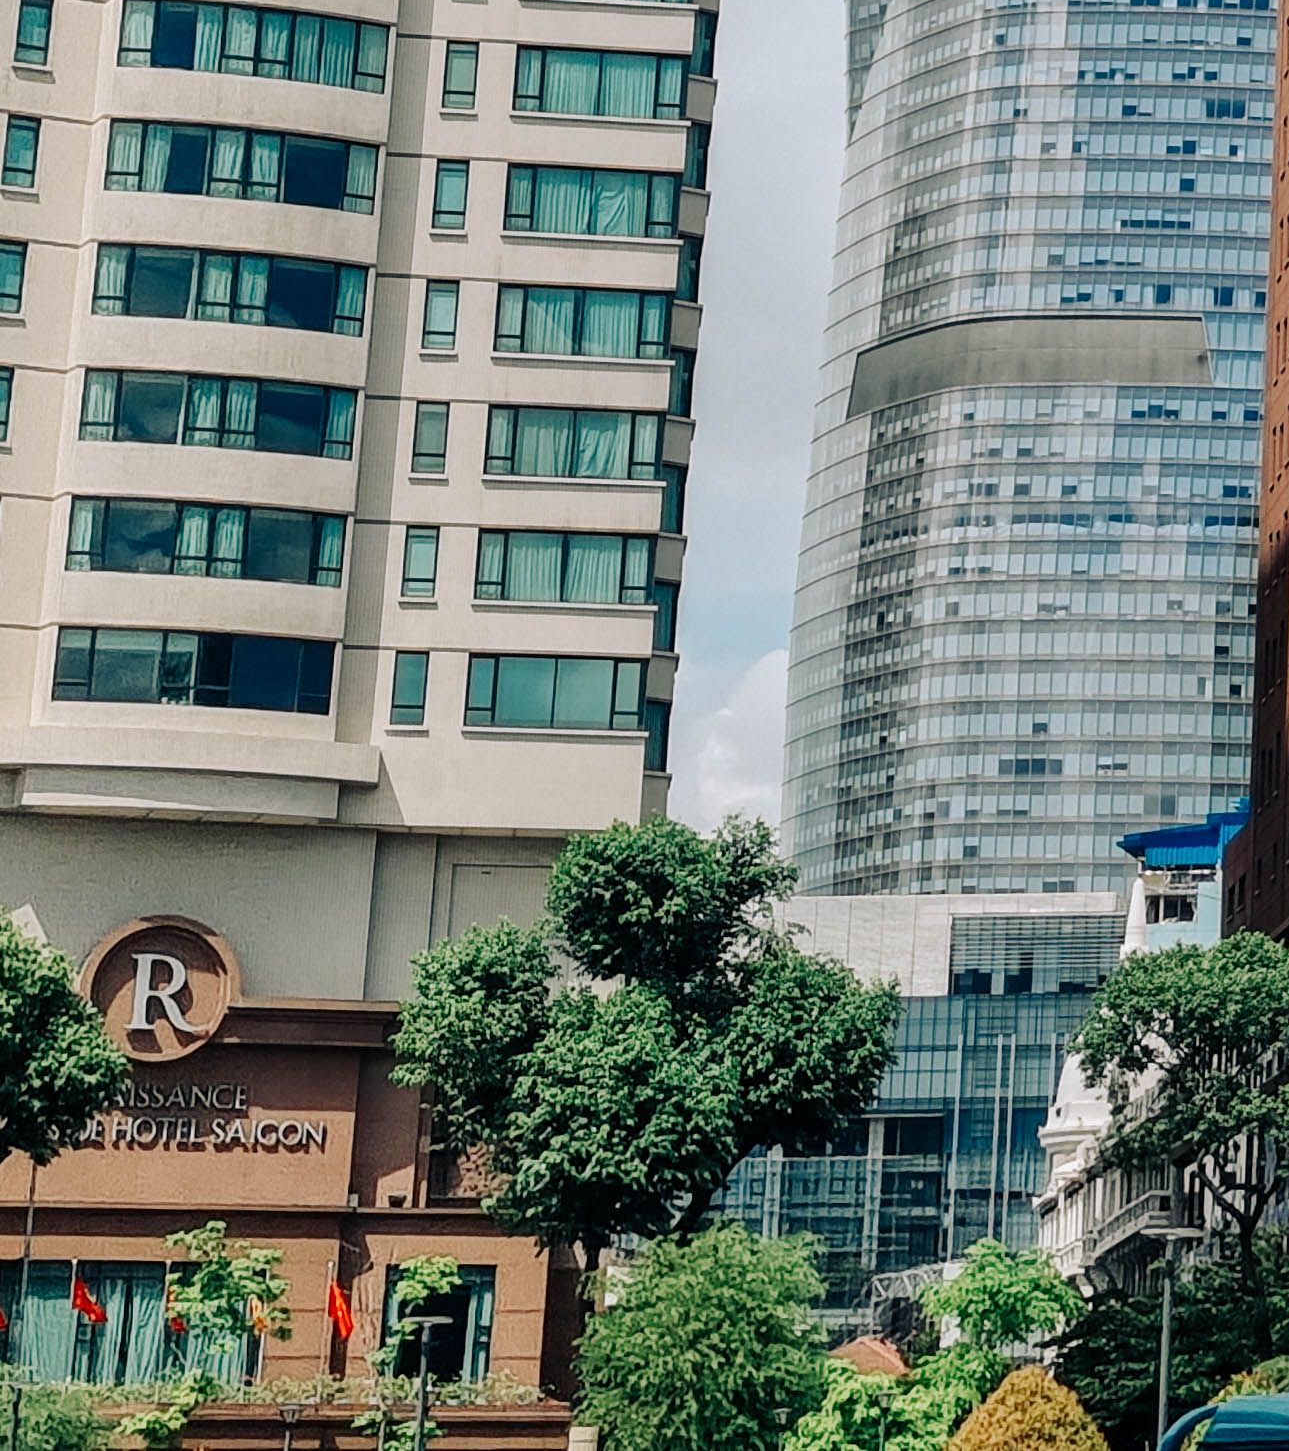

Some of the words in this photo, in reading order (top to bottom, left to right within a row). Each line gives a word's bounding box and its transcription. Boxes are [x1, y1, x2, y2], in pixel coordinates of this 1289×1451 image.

[123, 952, 198, 1034] R
[111, 1116, 205, 1144] HOTEL
[210, 1118, 326, 1148] SAIGON
